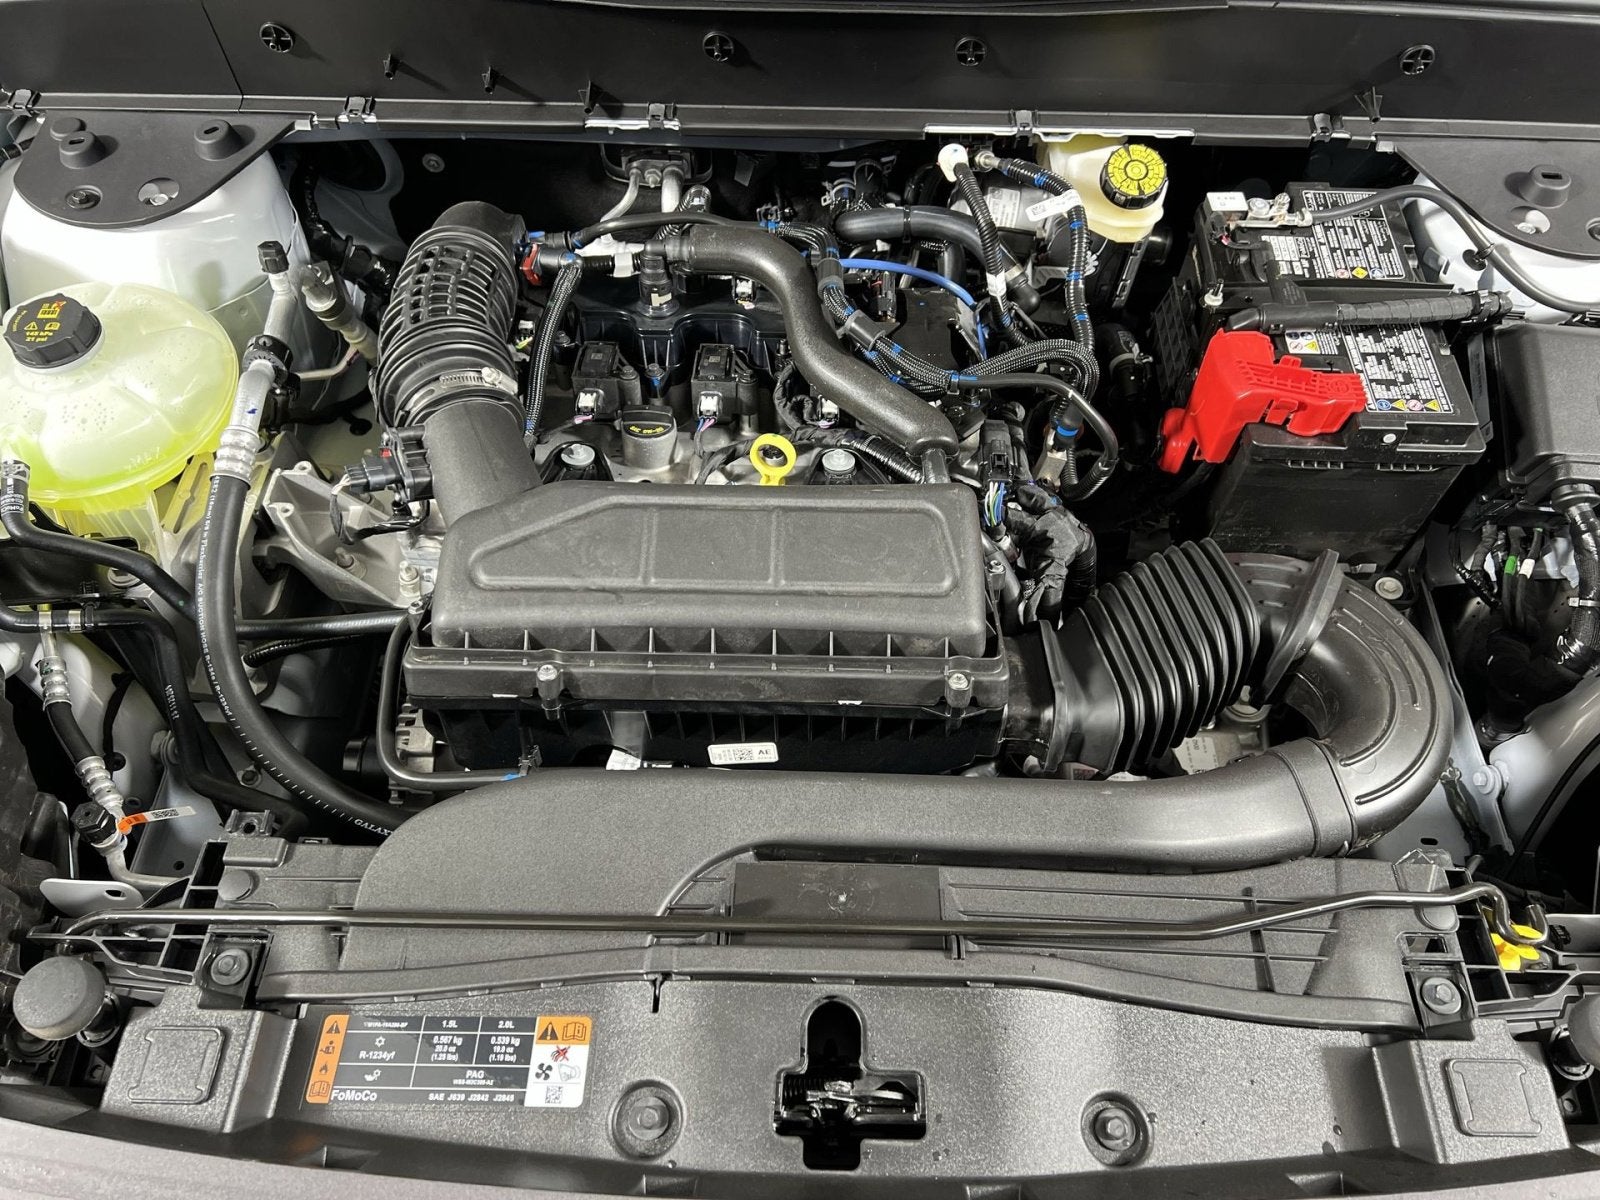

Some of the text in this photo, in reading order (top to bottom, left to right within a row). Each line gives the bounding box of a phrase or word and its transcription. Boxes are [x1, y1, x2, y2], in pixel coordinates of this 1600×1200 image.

[442, 1020, 458, 1028] 1.5L
[498, 1020, 515, 1029] 2.0L
[453, 1036, 463, 1046] kg
[490, 1036, 520, 1047] 0.539 kg
[359, 1050, 396, 1061] R-1234yf
[466, 1070, 485, 1079] PAG
[330, 1089, 378, 1102] FoMoCo
[428, 1093, 445, 1101] SAE
[447, 1093, 465, 1101] J639
